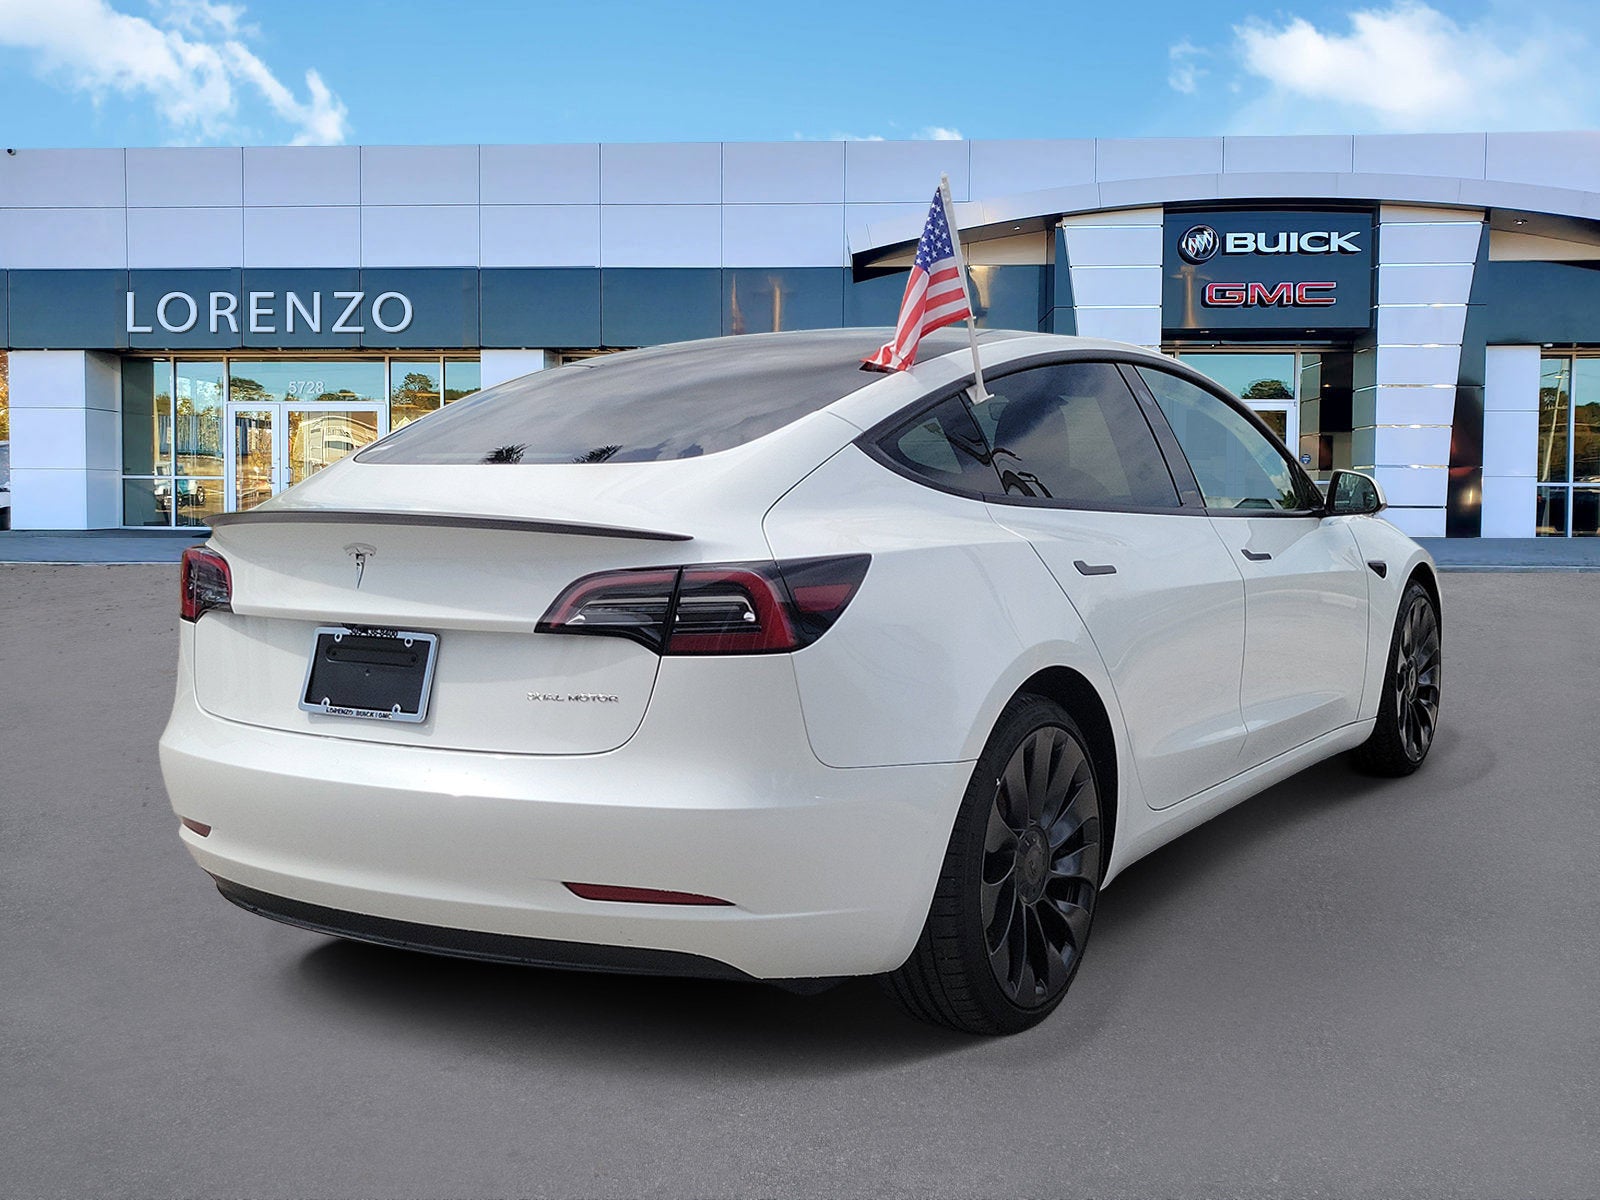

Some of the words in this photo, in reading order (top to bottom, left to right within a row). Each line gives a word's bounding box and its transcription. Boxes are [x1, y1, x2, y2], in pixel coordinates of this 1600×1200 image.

[1224, 231, 1362, 254] BUICK
[1203, 281, 1337, 307] GMC
[126, 291, 413, 333] LORENZO
[288, 380, 325, 394] 5728
[568, 693, 619, 703] MOTOR
[325, 706, 353, 716] LORENZO
[356, 710, 374, 718] BUICK
